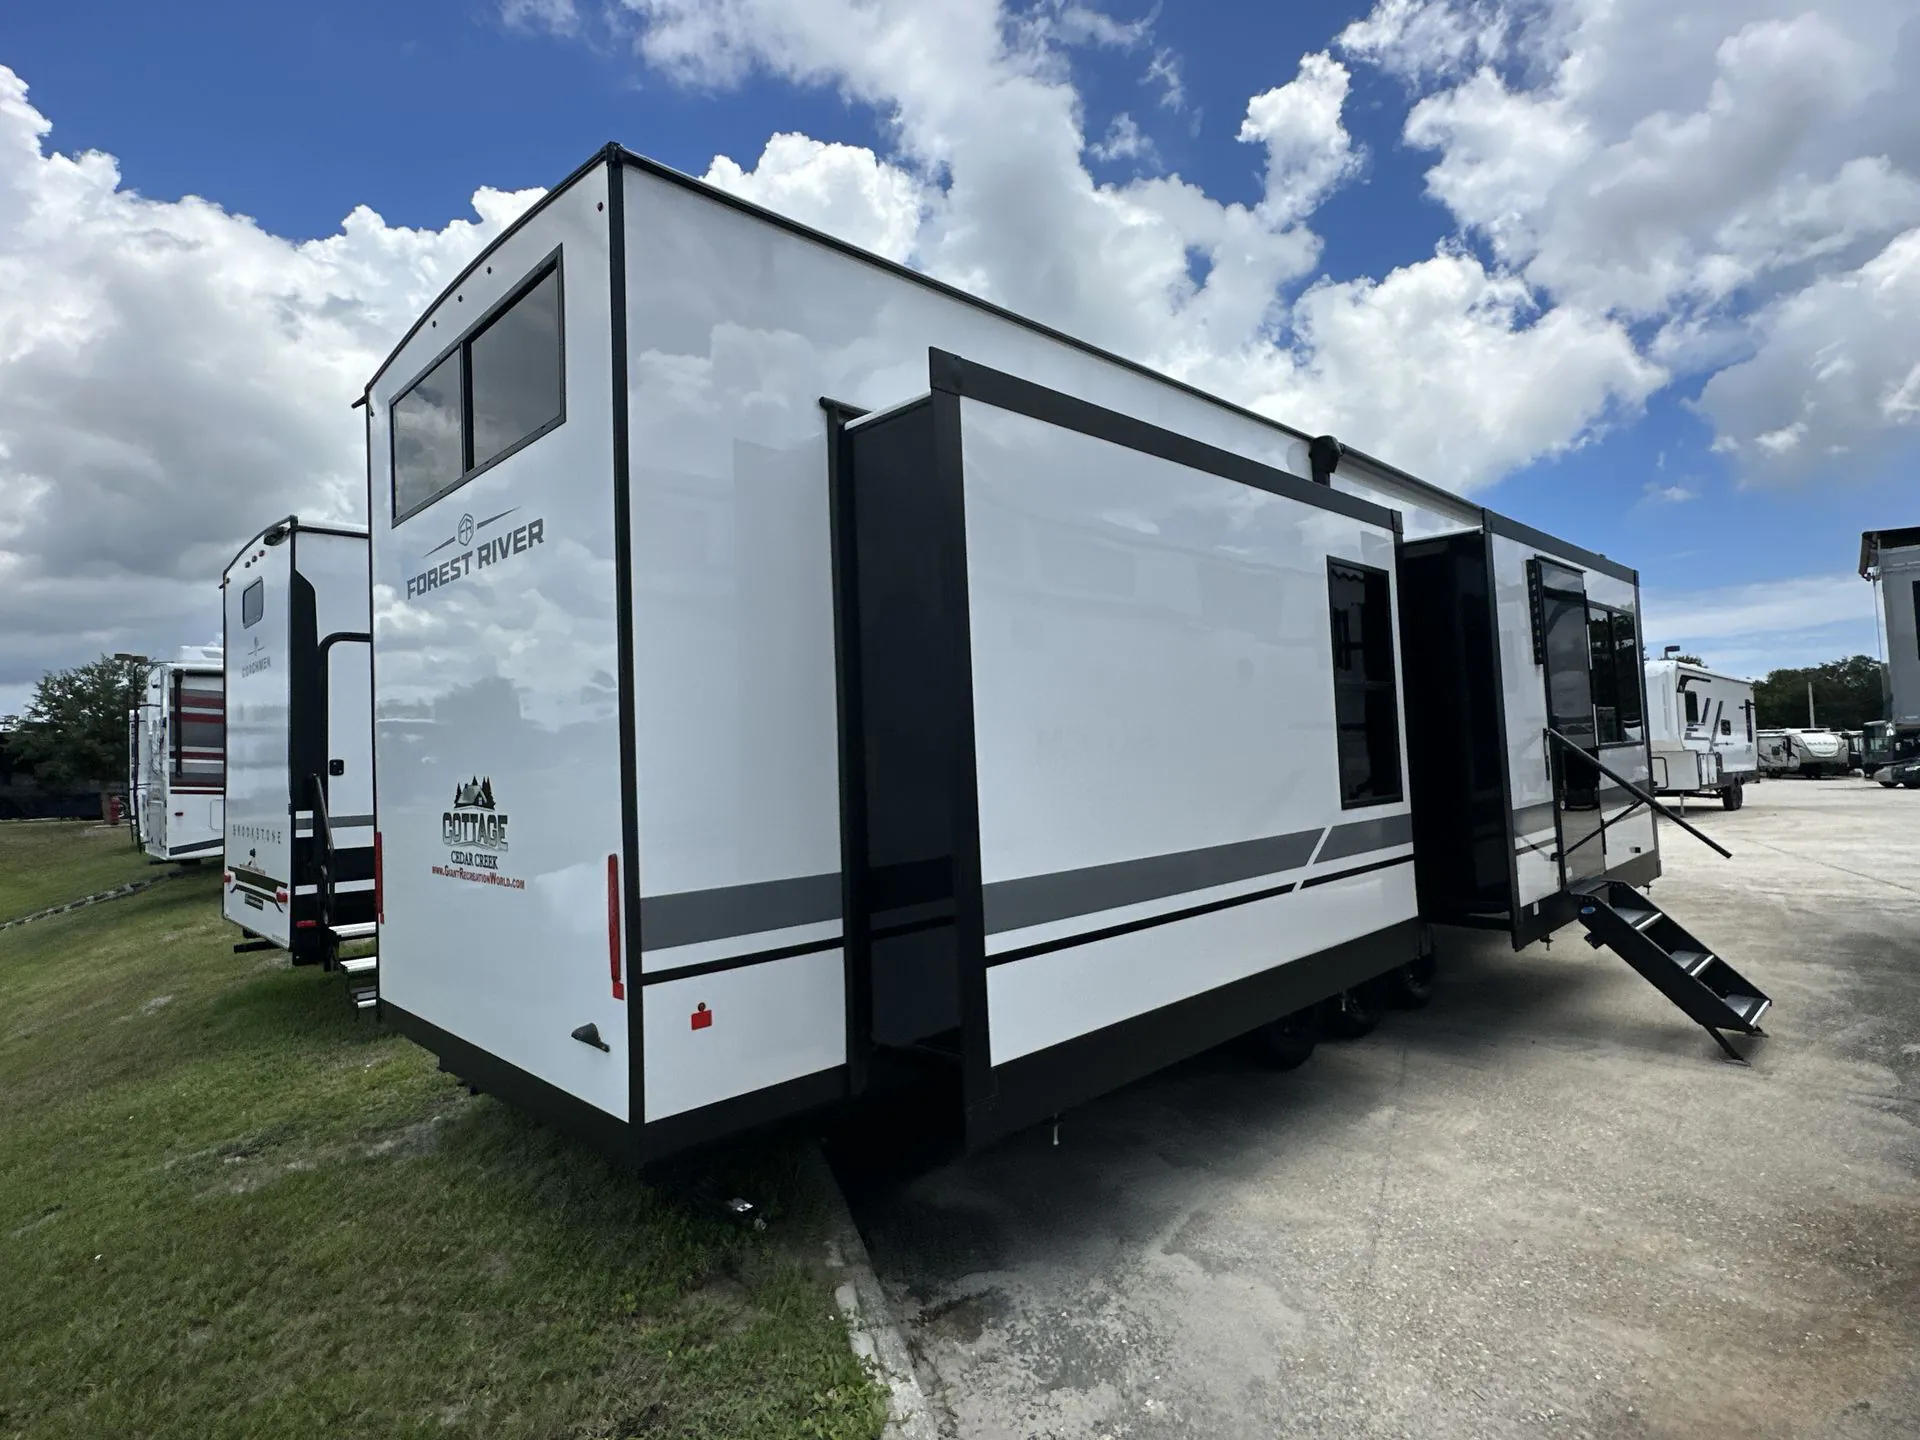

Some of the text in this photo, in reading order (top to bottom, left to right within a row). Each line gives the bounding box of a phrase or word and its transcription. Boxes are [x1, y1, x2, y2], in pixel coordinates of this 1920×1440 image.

[406, 518, 544, 600] FOREST RIVER
[442, 812, 508, 852] COTTAGE
[451, 851, 498, 870] CEDAR CREEK
